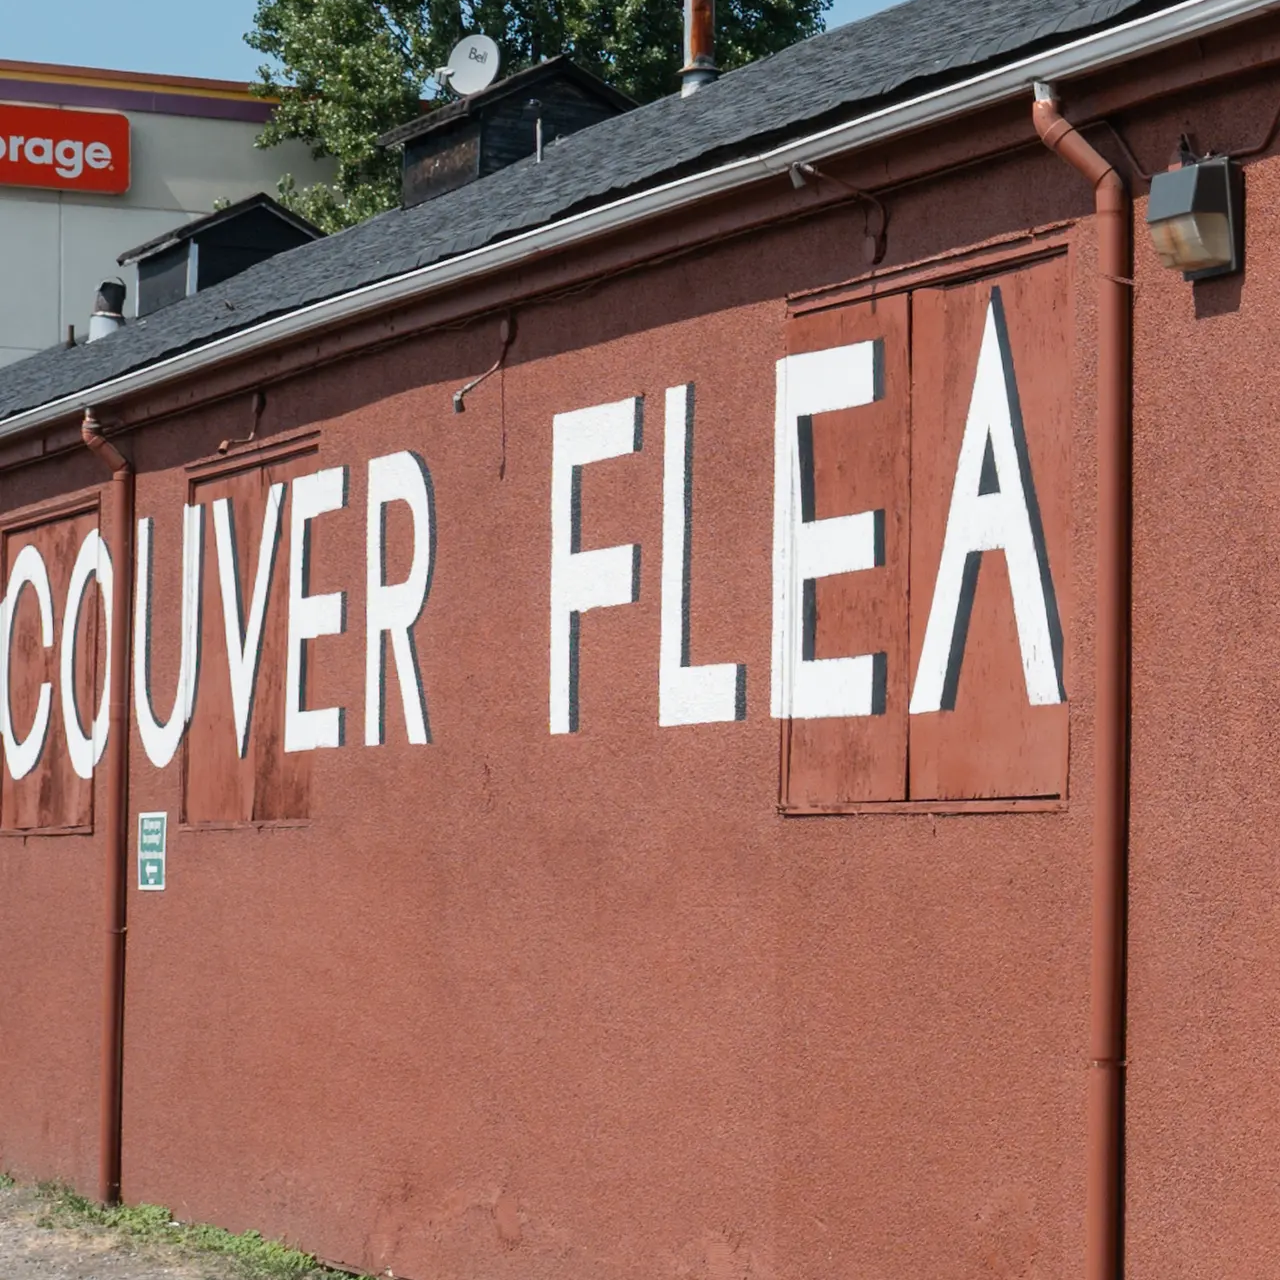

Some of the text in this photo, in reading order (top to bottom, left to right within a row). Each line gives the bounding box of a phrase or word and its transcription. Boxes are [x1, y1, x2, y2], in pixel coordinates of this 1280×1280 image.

[468, 46, 488, 65] Bell
[0, 135, 112, 179] rage
[0, 450, 437, 780] COUVER
[549, 285, 1067, 735] FLEA
